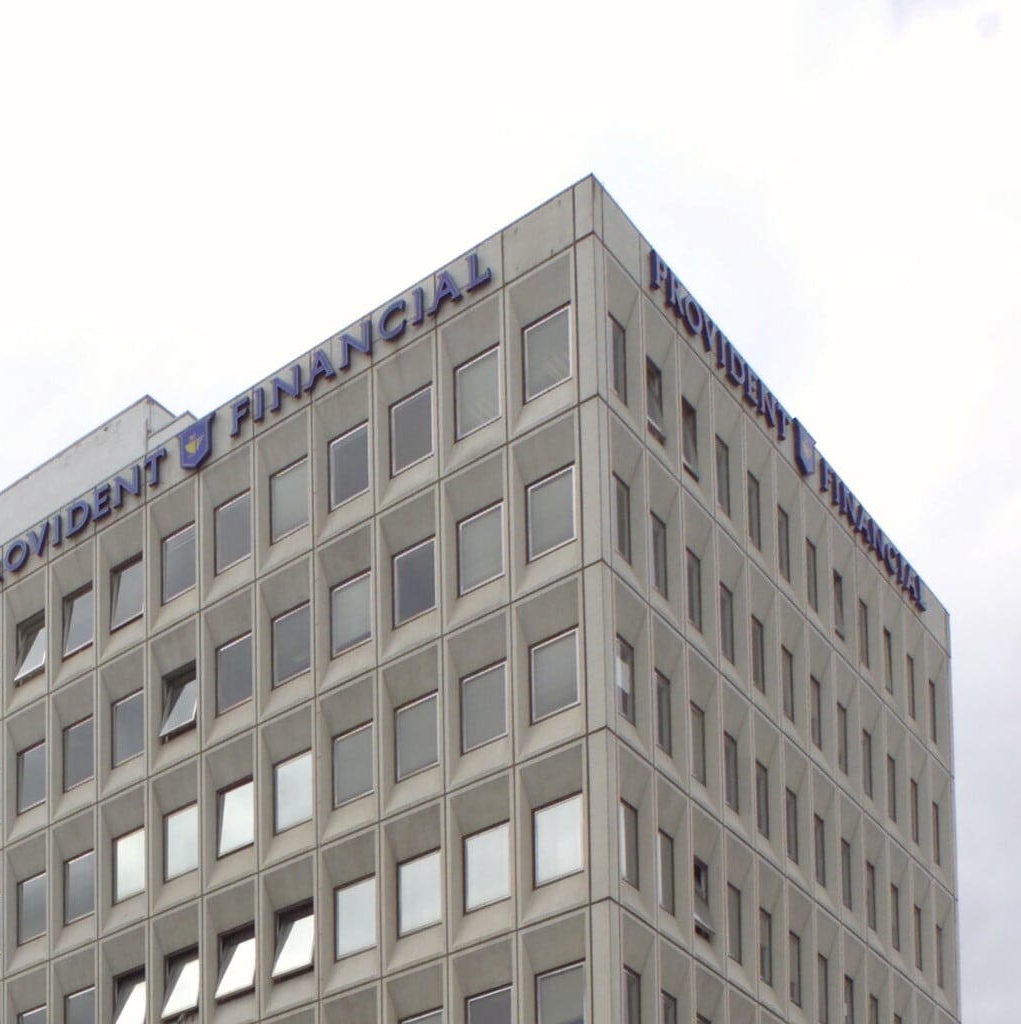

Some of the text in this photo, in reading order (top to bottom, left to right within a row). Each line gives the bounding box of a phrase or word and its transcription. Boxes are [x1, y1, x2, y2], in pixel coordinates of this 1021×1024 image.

[229, 252, 492, 438] FINANCIAL
[650, 248, 927, 612] PROVIDENT FINANCIAL
